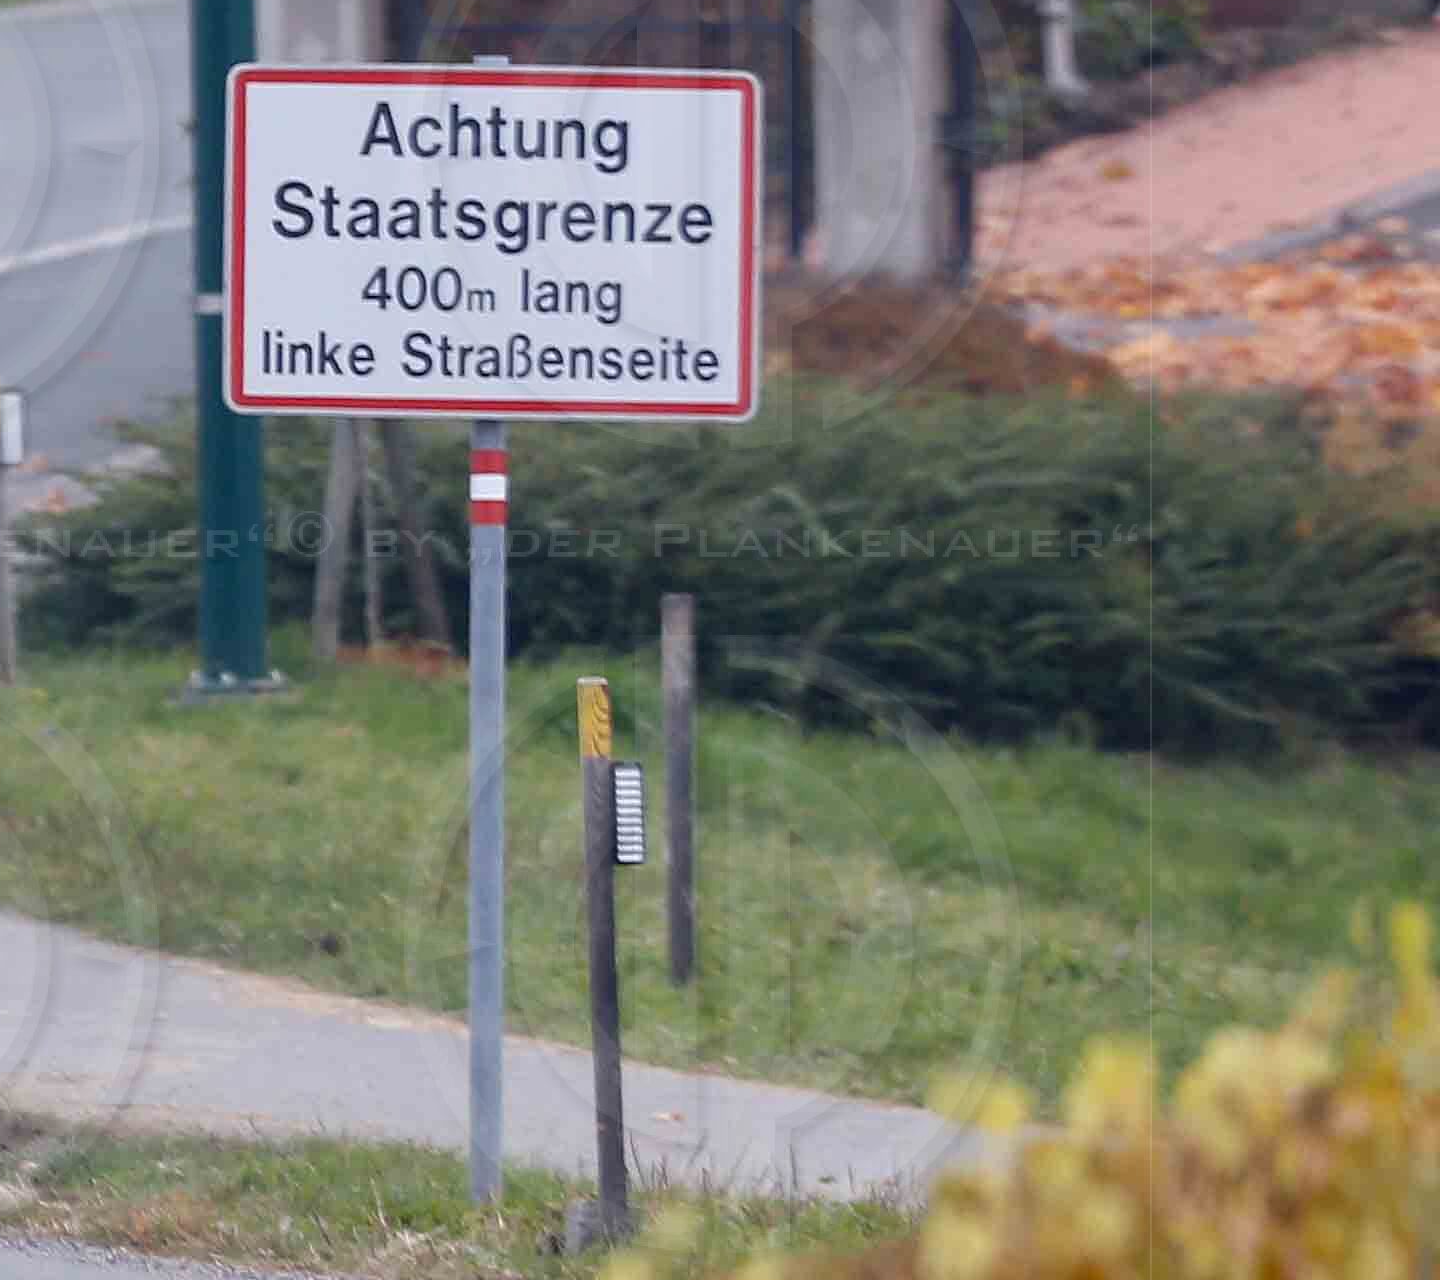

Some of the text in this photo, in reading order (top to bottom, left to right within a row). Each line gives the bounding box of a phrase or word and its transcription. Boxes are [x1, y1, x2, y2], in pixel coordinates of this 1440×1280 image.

[360, 101, 629, 173] Achtung
[271, 181, 714, 254] Staatsgrenze
[361, 266, 623, 324] 400m lang
[261, 330, 720, 382] linke Straßenseite
